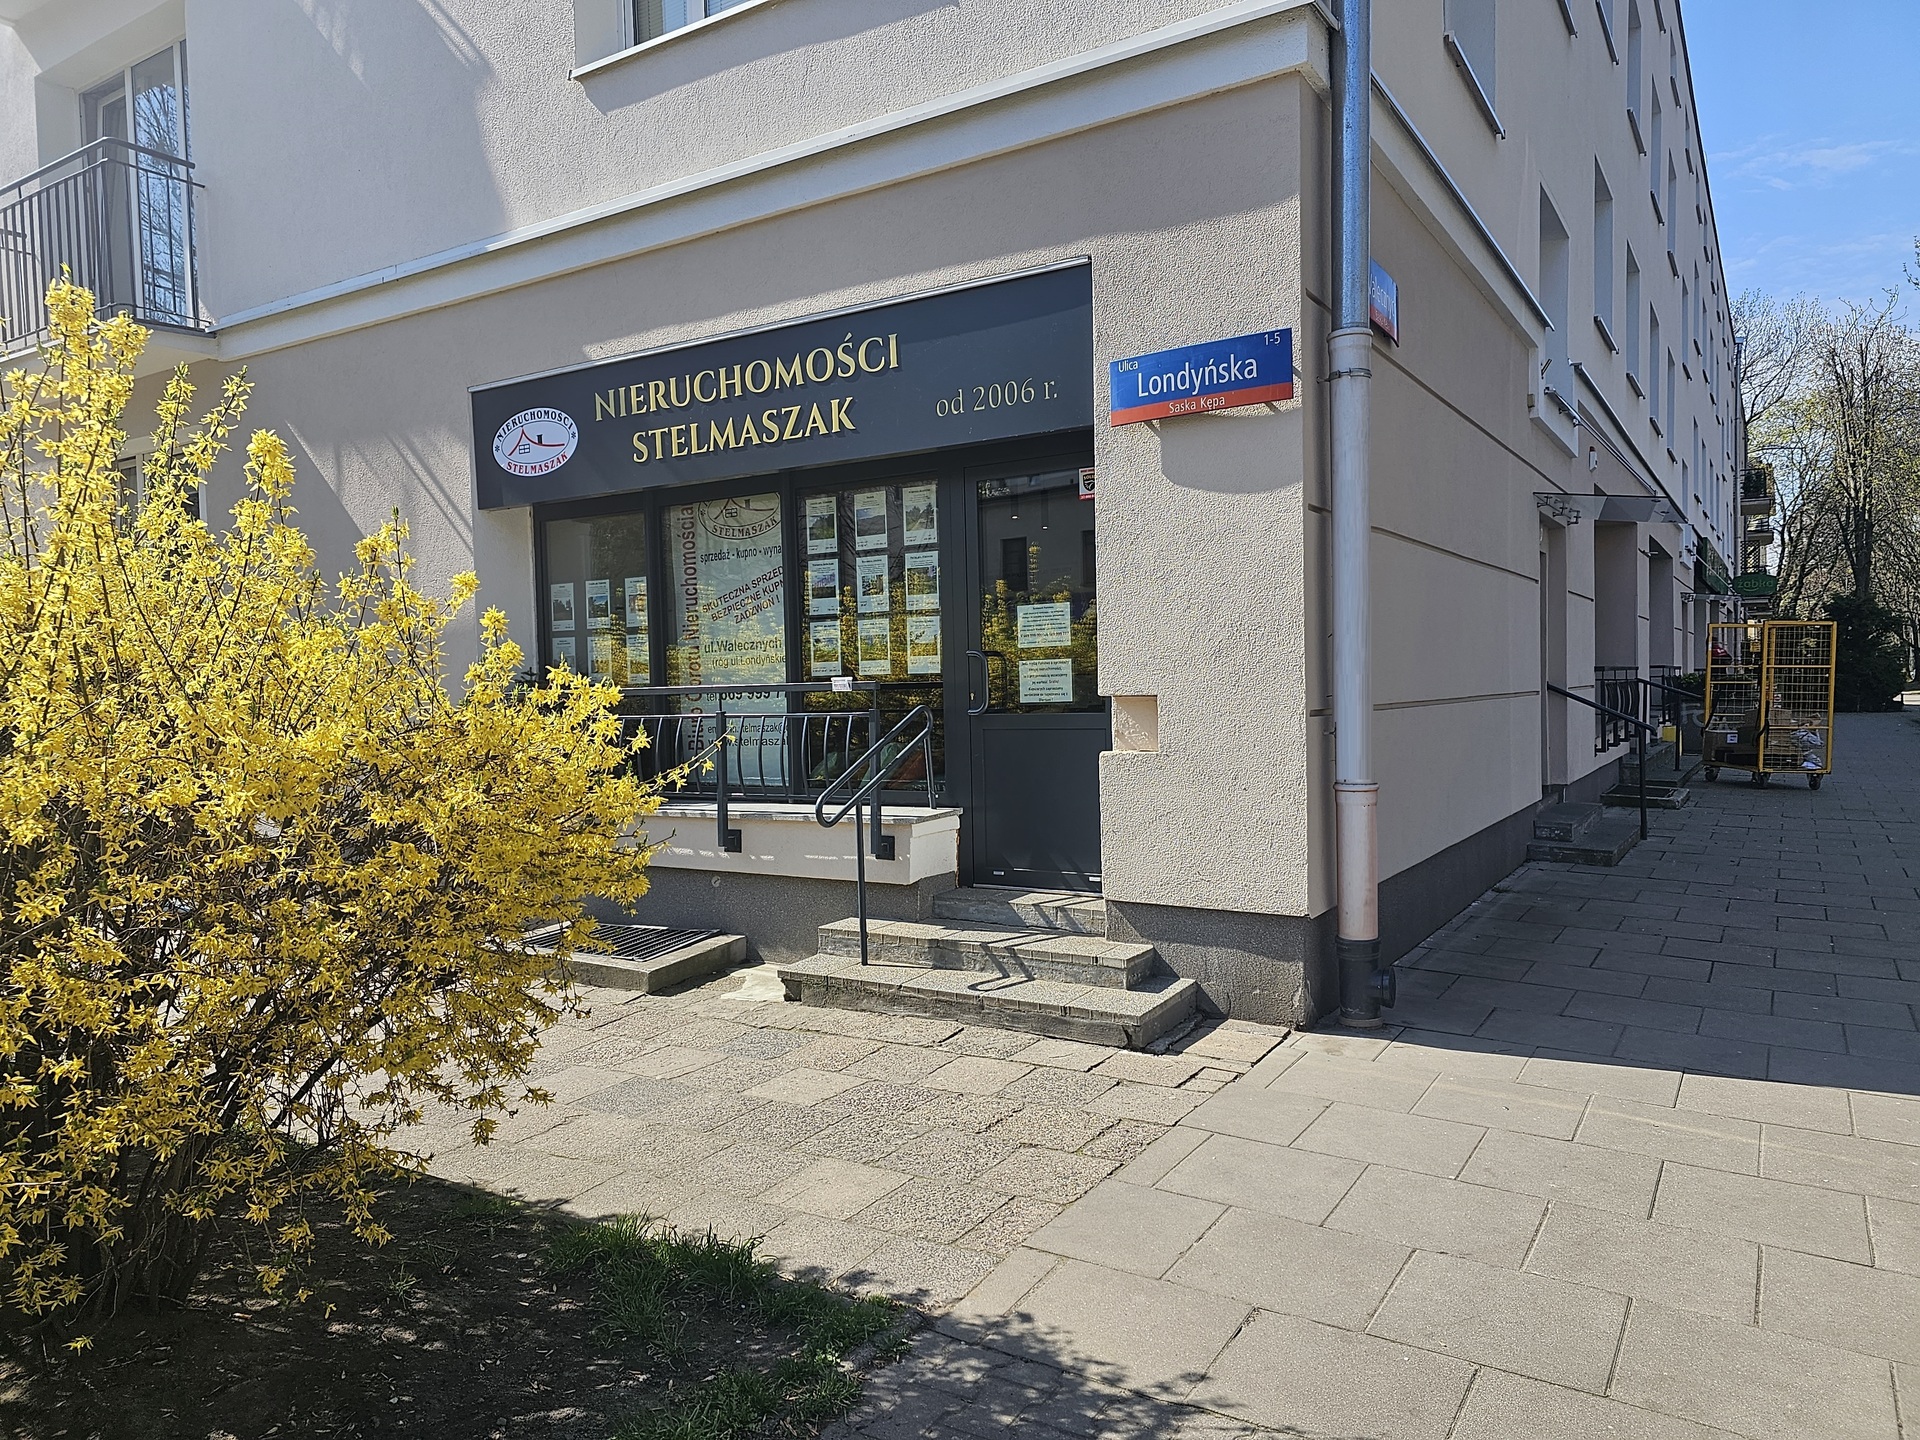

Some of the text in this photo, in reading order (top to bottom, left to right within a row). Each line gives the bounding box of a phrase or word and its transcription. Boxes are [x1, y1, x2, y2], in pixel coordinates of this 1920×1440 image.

[1263, 331, 1281, 346] 1-5
[594, 331, 899, 422] NIERUCHOMOŚCI
[1118, 359, 1139, 373] Ulica
[1138, 353, 1258, 397] Londyńska
[936, 377, 1058, 417] od 2006 r.
[1169, 395, 1226, 414] Saska Kępa
[632, 396, 856, 463] STELMASZAK
[506, 452, 568, 475] STELMASZAK
[711, 516, 778, 538] STELMASZAK
[700, 548, 731, 566] sprzedaż
[737, 546, 758, 560] kupno
[763, 544, 782, 558] wyna
[702, 584, 751, 613] SKUTECZNA
[711, 591, 762, 622] BEZPIECZNE
[734, 595, 775, 624] ZADZWOŃ
